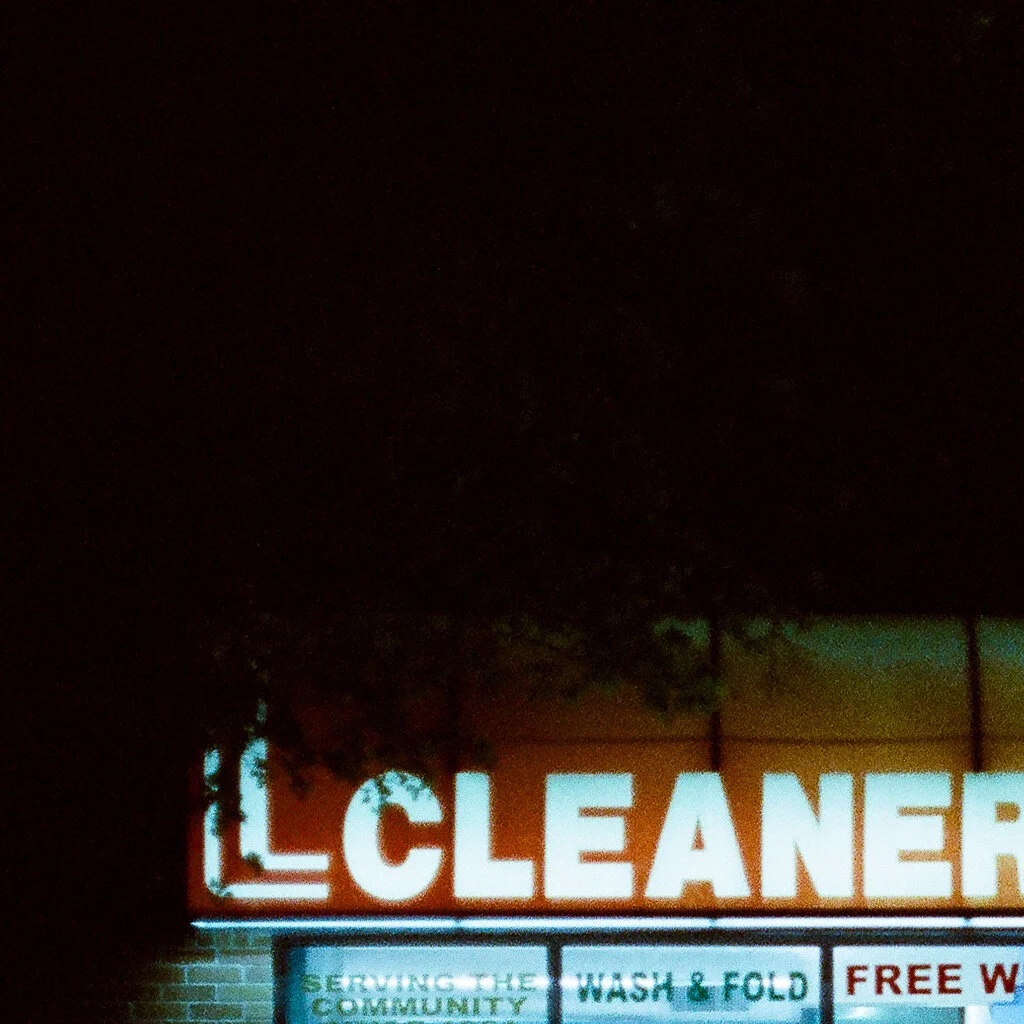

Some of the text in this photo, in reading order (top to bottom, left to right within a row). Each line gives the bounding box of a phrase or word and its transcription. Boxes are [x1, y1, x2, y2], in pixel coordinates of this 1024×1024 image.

[301, 973, 536, 993] SERVING THE
[575, 971, 809, 1002] WASH & FOLD
[847, 964, 962, 996] FREE
[312, 997, 527, 1017] COMMUNITY
